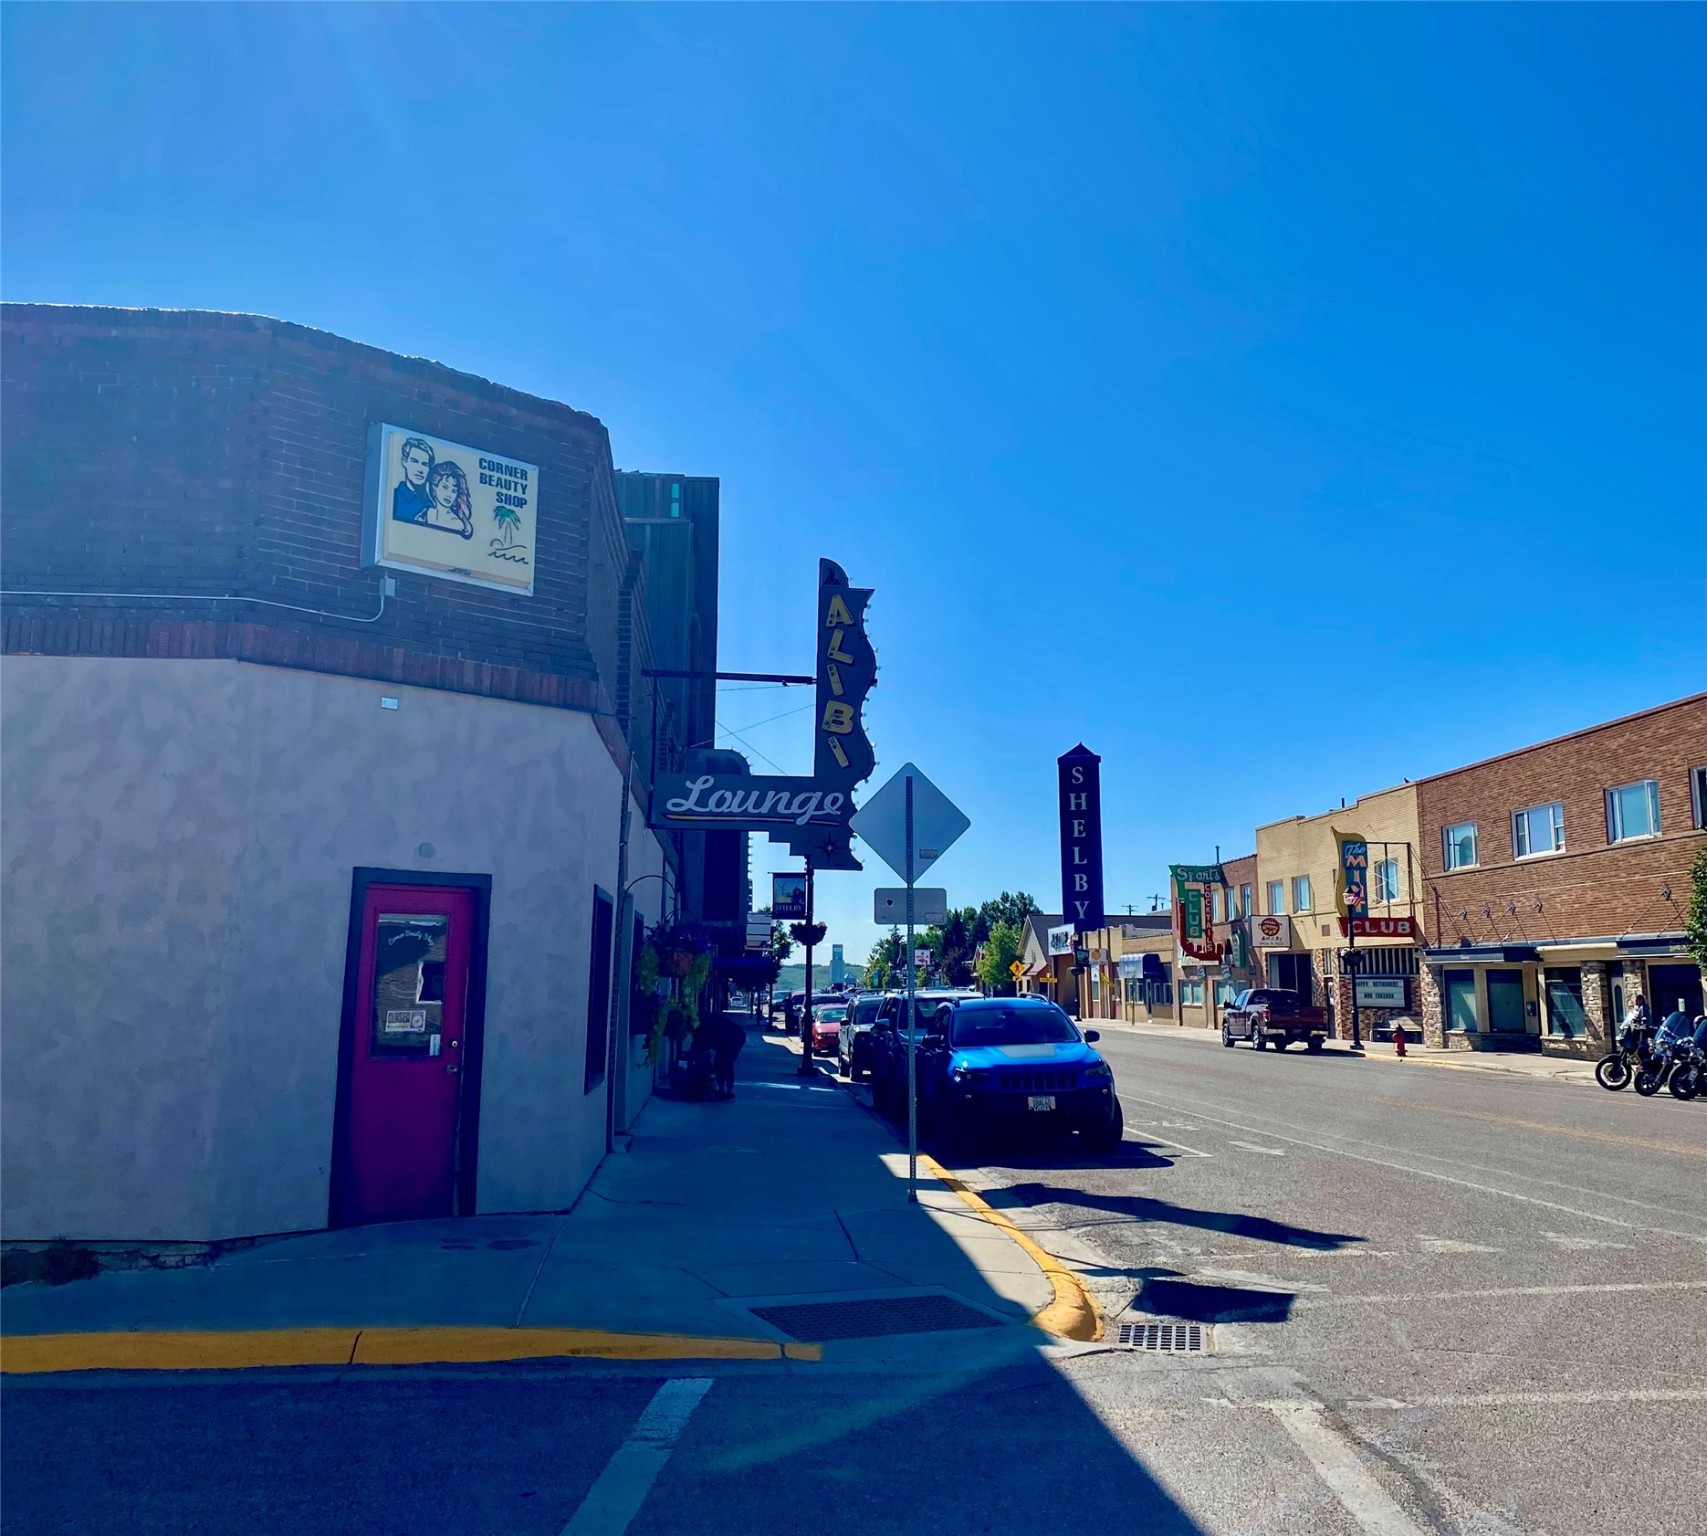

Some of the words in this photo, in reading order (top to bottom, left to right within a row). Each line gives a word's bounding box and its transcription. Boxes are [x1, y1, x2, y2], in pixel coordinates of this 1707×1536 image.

[478, 457, 528, 481] CORNER
[479, 472, 528, 495] BEAUTY
[496, 491, 528, 509] SHOP
[821, 594, 855, 768] ALIBI
[666, 775, 844, 825] Lounge
[1069, 766, 1090, 919] SHELBY
[1344, 843, 1366, 859] The
[1188, 891, 1200, 937] CLUB
[1204, 883, 1214, 952] COCKTAILS
[1352, 920, 1411, 934] CLUB
